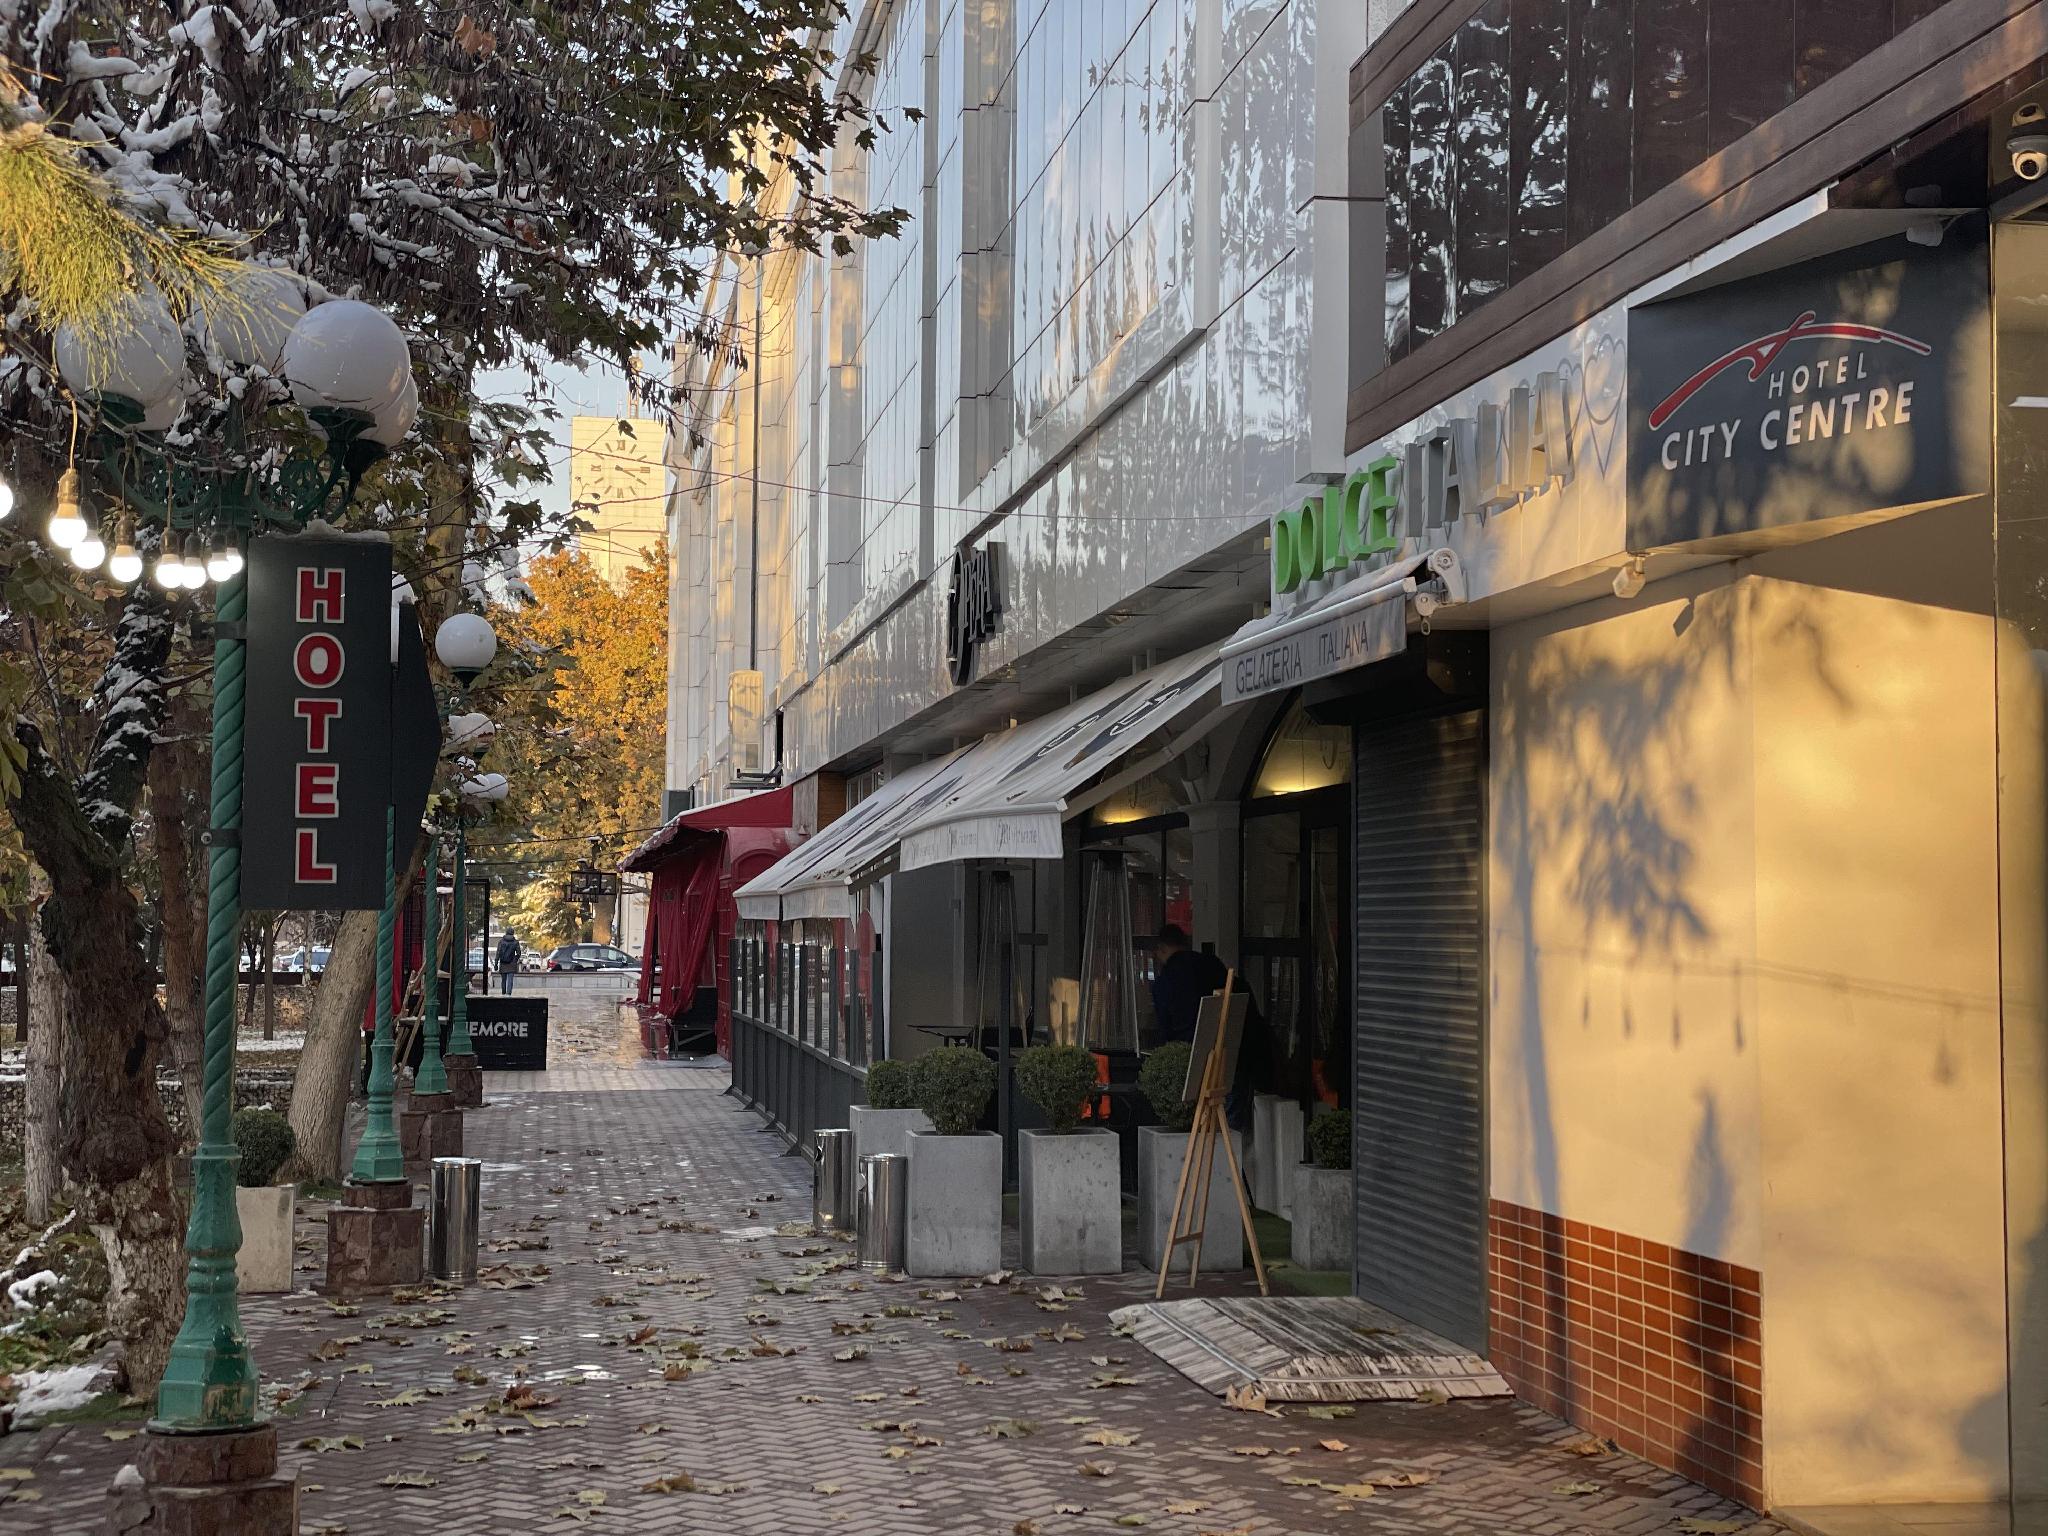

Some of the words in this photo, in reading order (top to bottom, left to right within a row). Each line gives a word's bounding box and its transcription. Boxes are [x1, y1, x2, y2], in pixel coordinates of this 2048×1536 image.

[1768, 352, 1868, 399] HOTEL
[1661, 419, 1742, 471] CITY
[1759, 381, 1915, 451] CENTRE
[1275, 452, 1398, 594] DOLCE
[1404, 371, 1576, 538] ITALIA
[1235, 642, 1303, 694] GELATERIA
[1317, 620, 1370, 667] ITALIANA
[293, 566, 346, 884] HOTEL
[465, 1021, 529, 1037] EMORE
